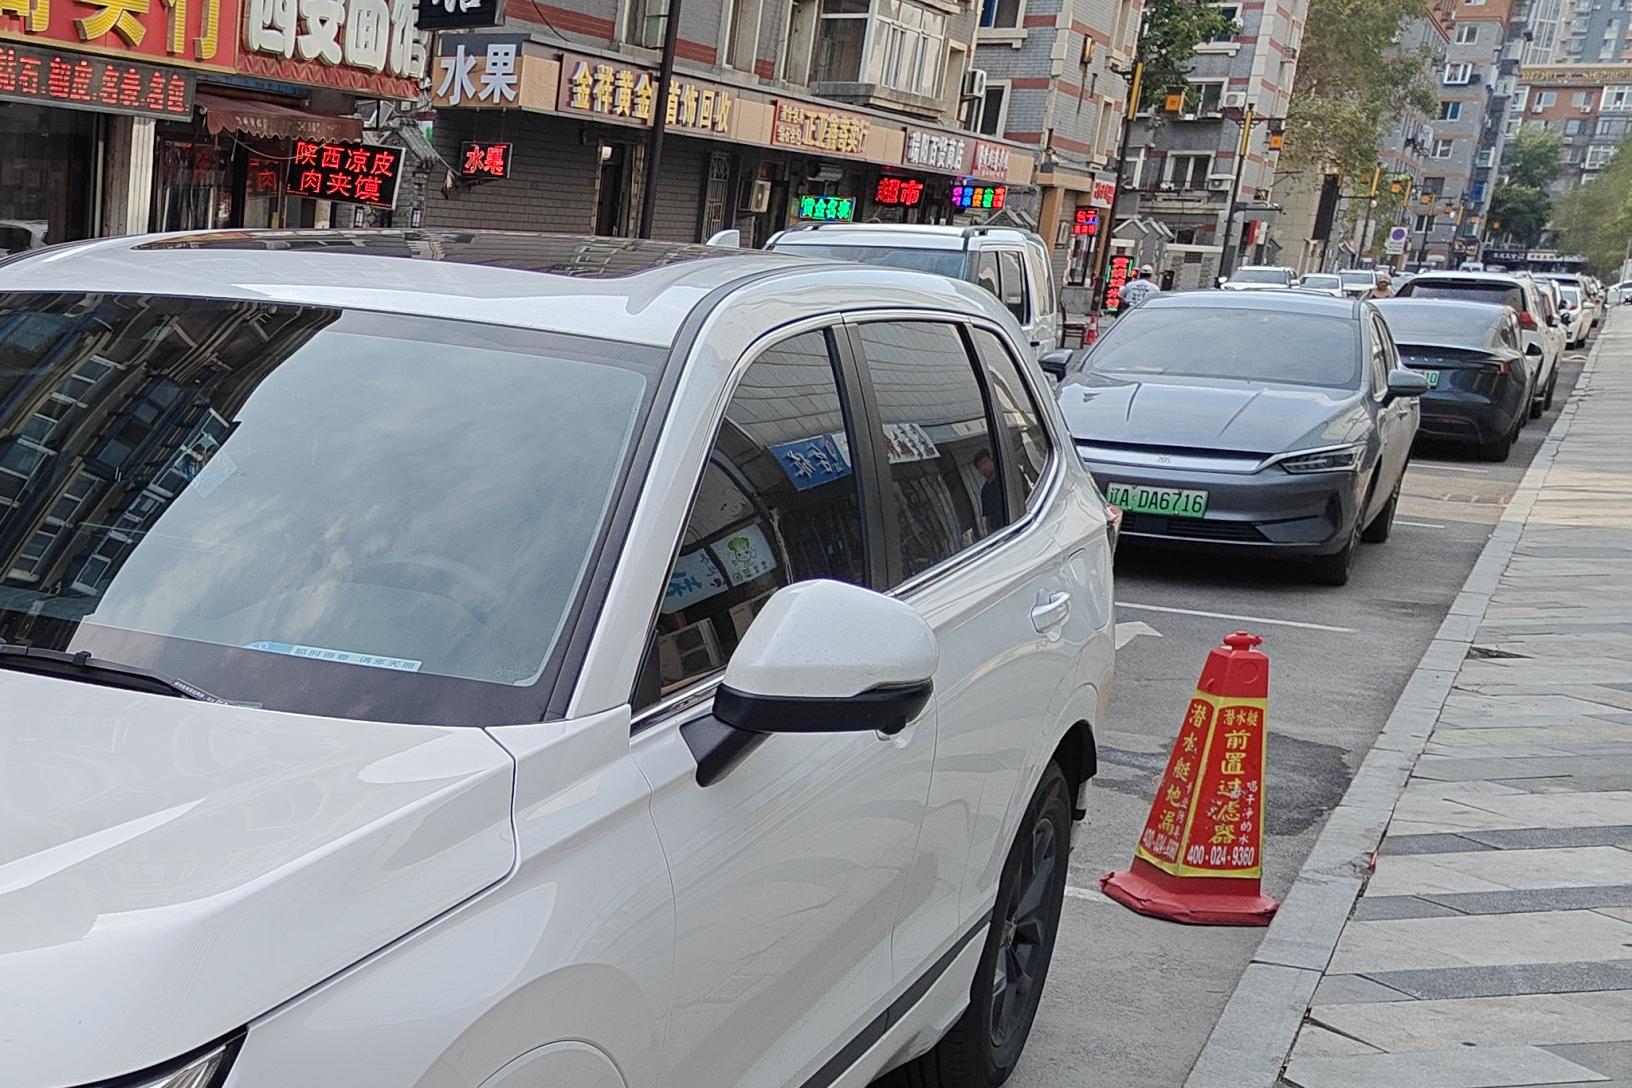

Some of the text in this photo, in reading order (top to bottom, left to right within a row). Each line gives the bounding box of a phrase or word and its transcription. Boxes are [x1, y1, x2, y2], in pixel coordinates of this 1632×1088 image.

[436, 43, 518, 106] 水果
[295, 140, 397, 177] 陕西凉皮
[465, 144, 507, 176] 水果
[300, 170, 383, 201] 肉夹馍
[875, 177, 925, 207] 超市
[1222, 708, 1259, 728] 潜水艇
